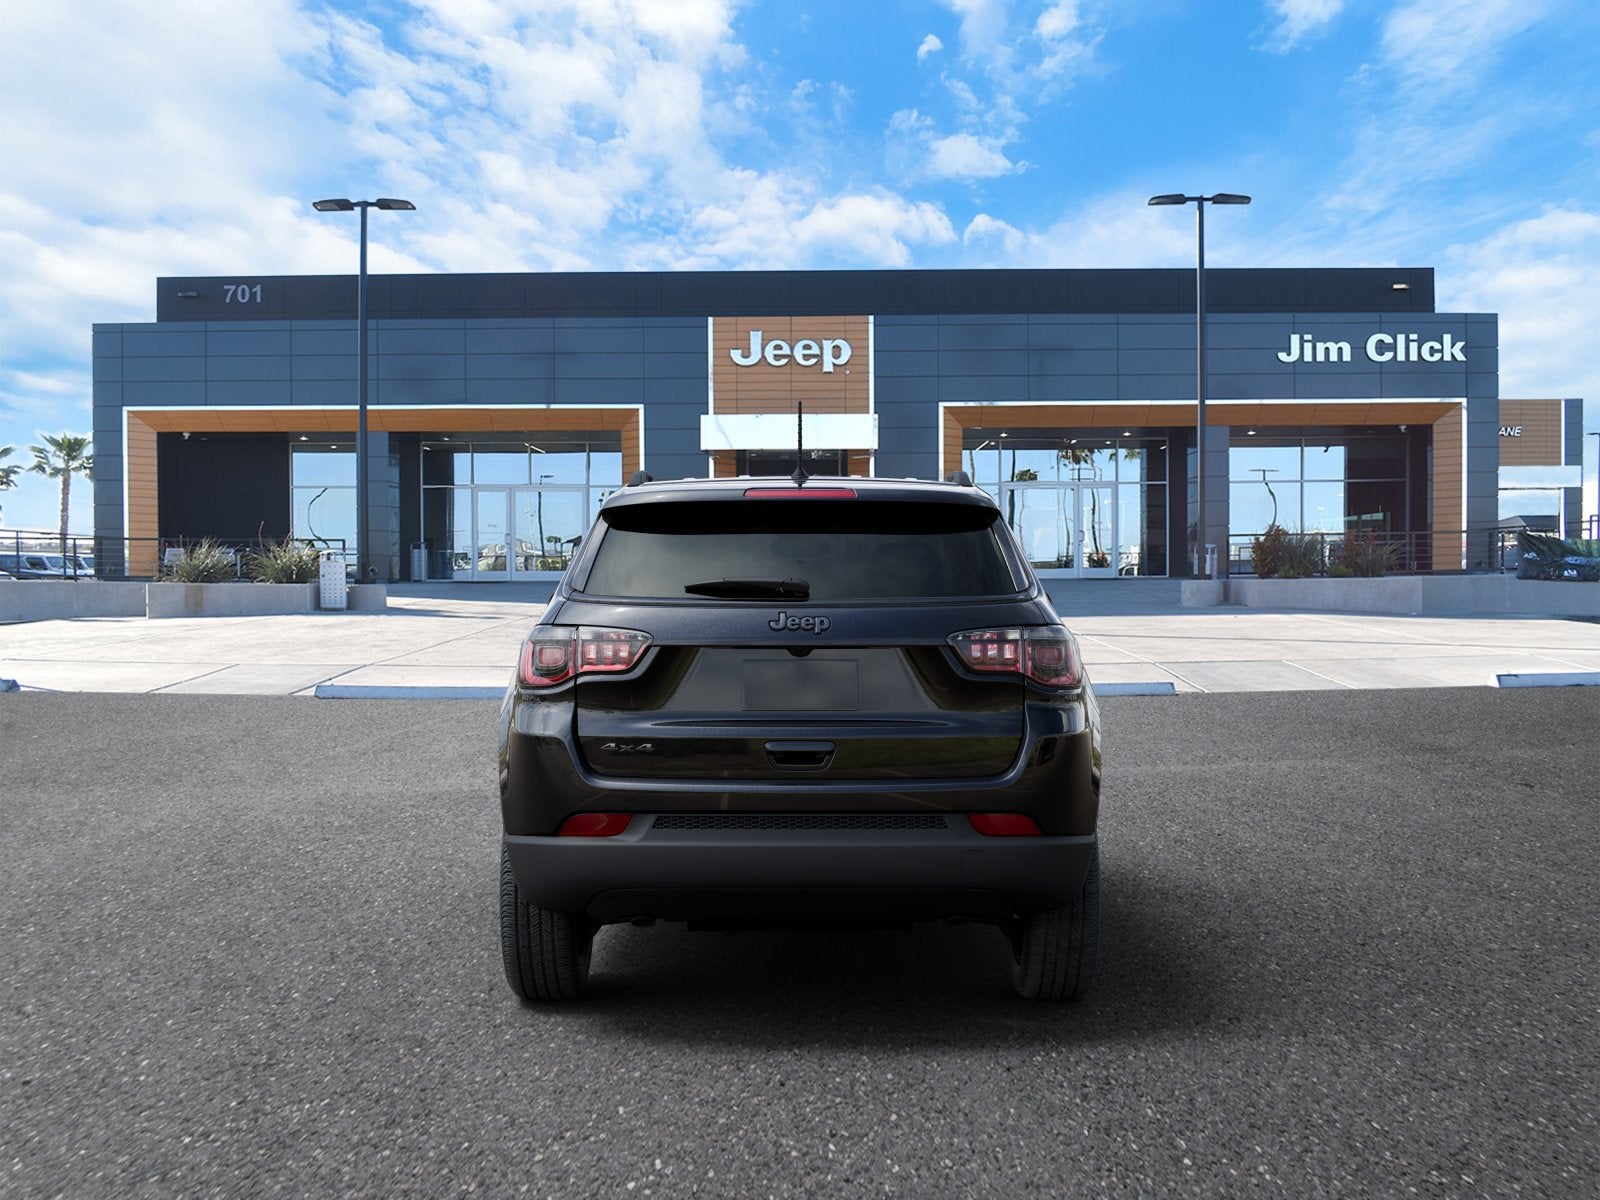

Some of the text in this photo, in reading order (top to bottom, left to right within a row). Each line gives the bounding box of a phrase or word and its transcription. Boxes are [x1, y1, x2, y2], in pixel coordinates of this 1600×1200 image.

[223, 284, 262, 303] 701
[729, 330, 852, 374] Jeep
[1277, 333, 1467, 362] Jim Click
[768, 611, 832, 635] Jeep
